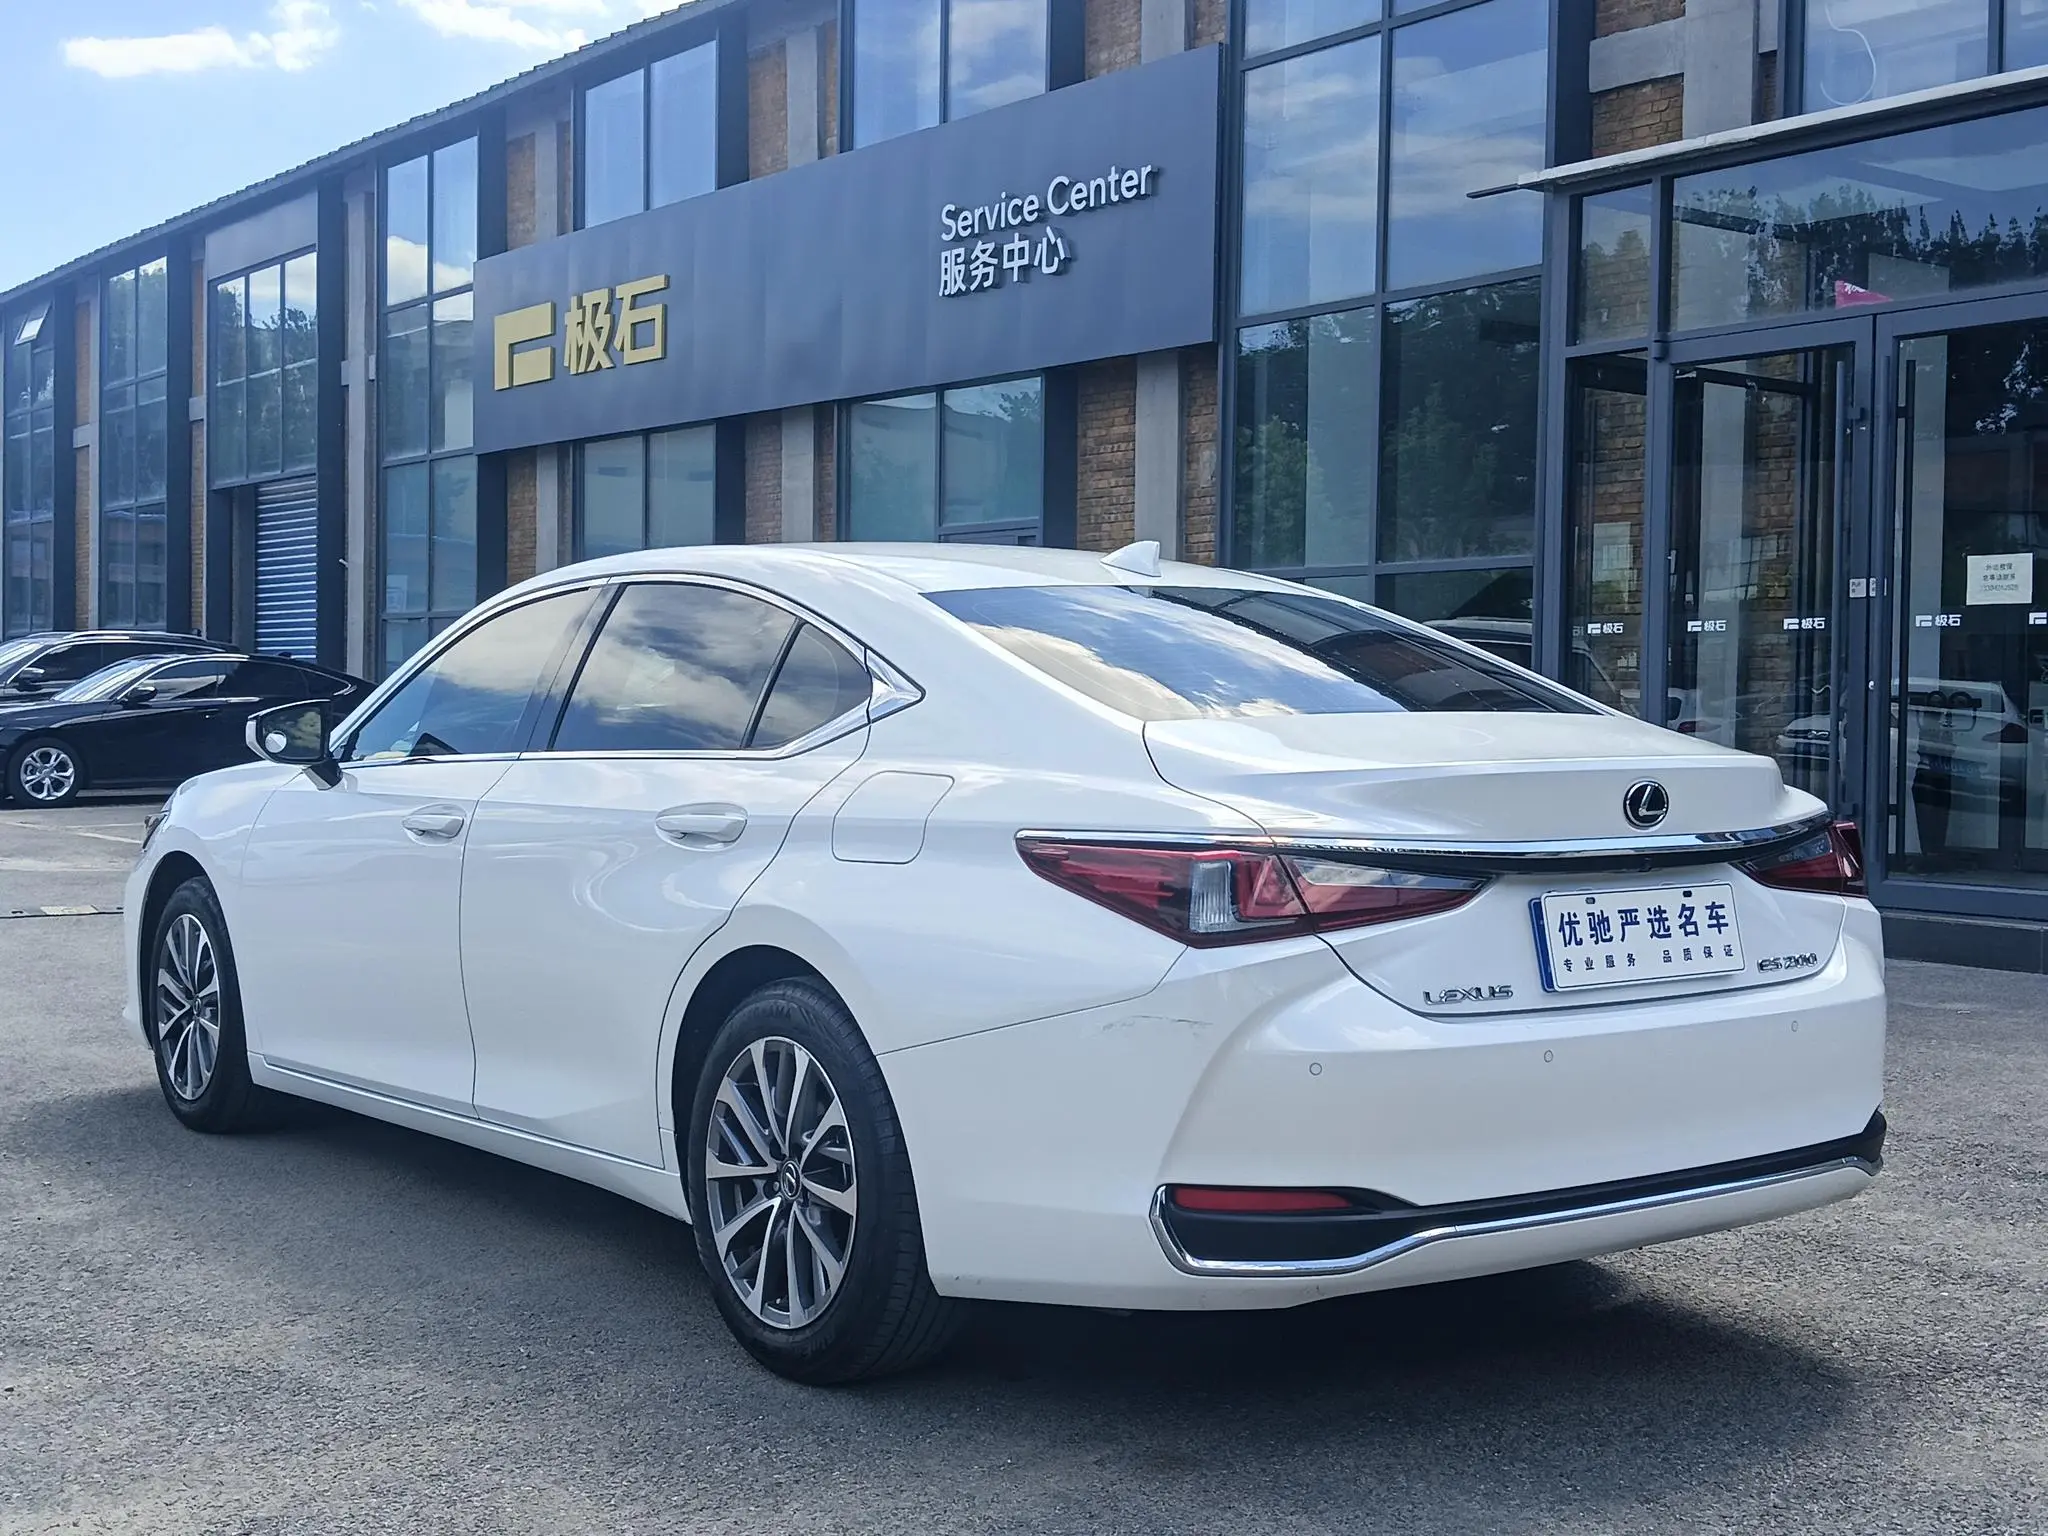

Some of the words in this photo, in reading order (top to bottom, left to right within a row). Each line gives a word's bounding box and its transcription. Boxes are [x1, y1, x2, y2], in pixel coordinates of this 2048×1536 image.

[941, 191, 1040, 242] Service
[1046, 164, 1153, 216] Center
[938, 225, 1068, 297] 服务中心
[563, 274, 669, 375] 极石
[1558, 901, 1729, 948] 优驰严选名车
[1563, 952, 1637, 973] 专业服务
[1662, 944, 1734, 964] 品质保证
[1423, 984, 1514, 1006] LEXUS
